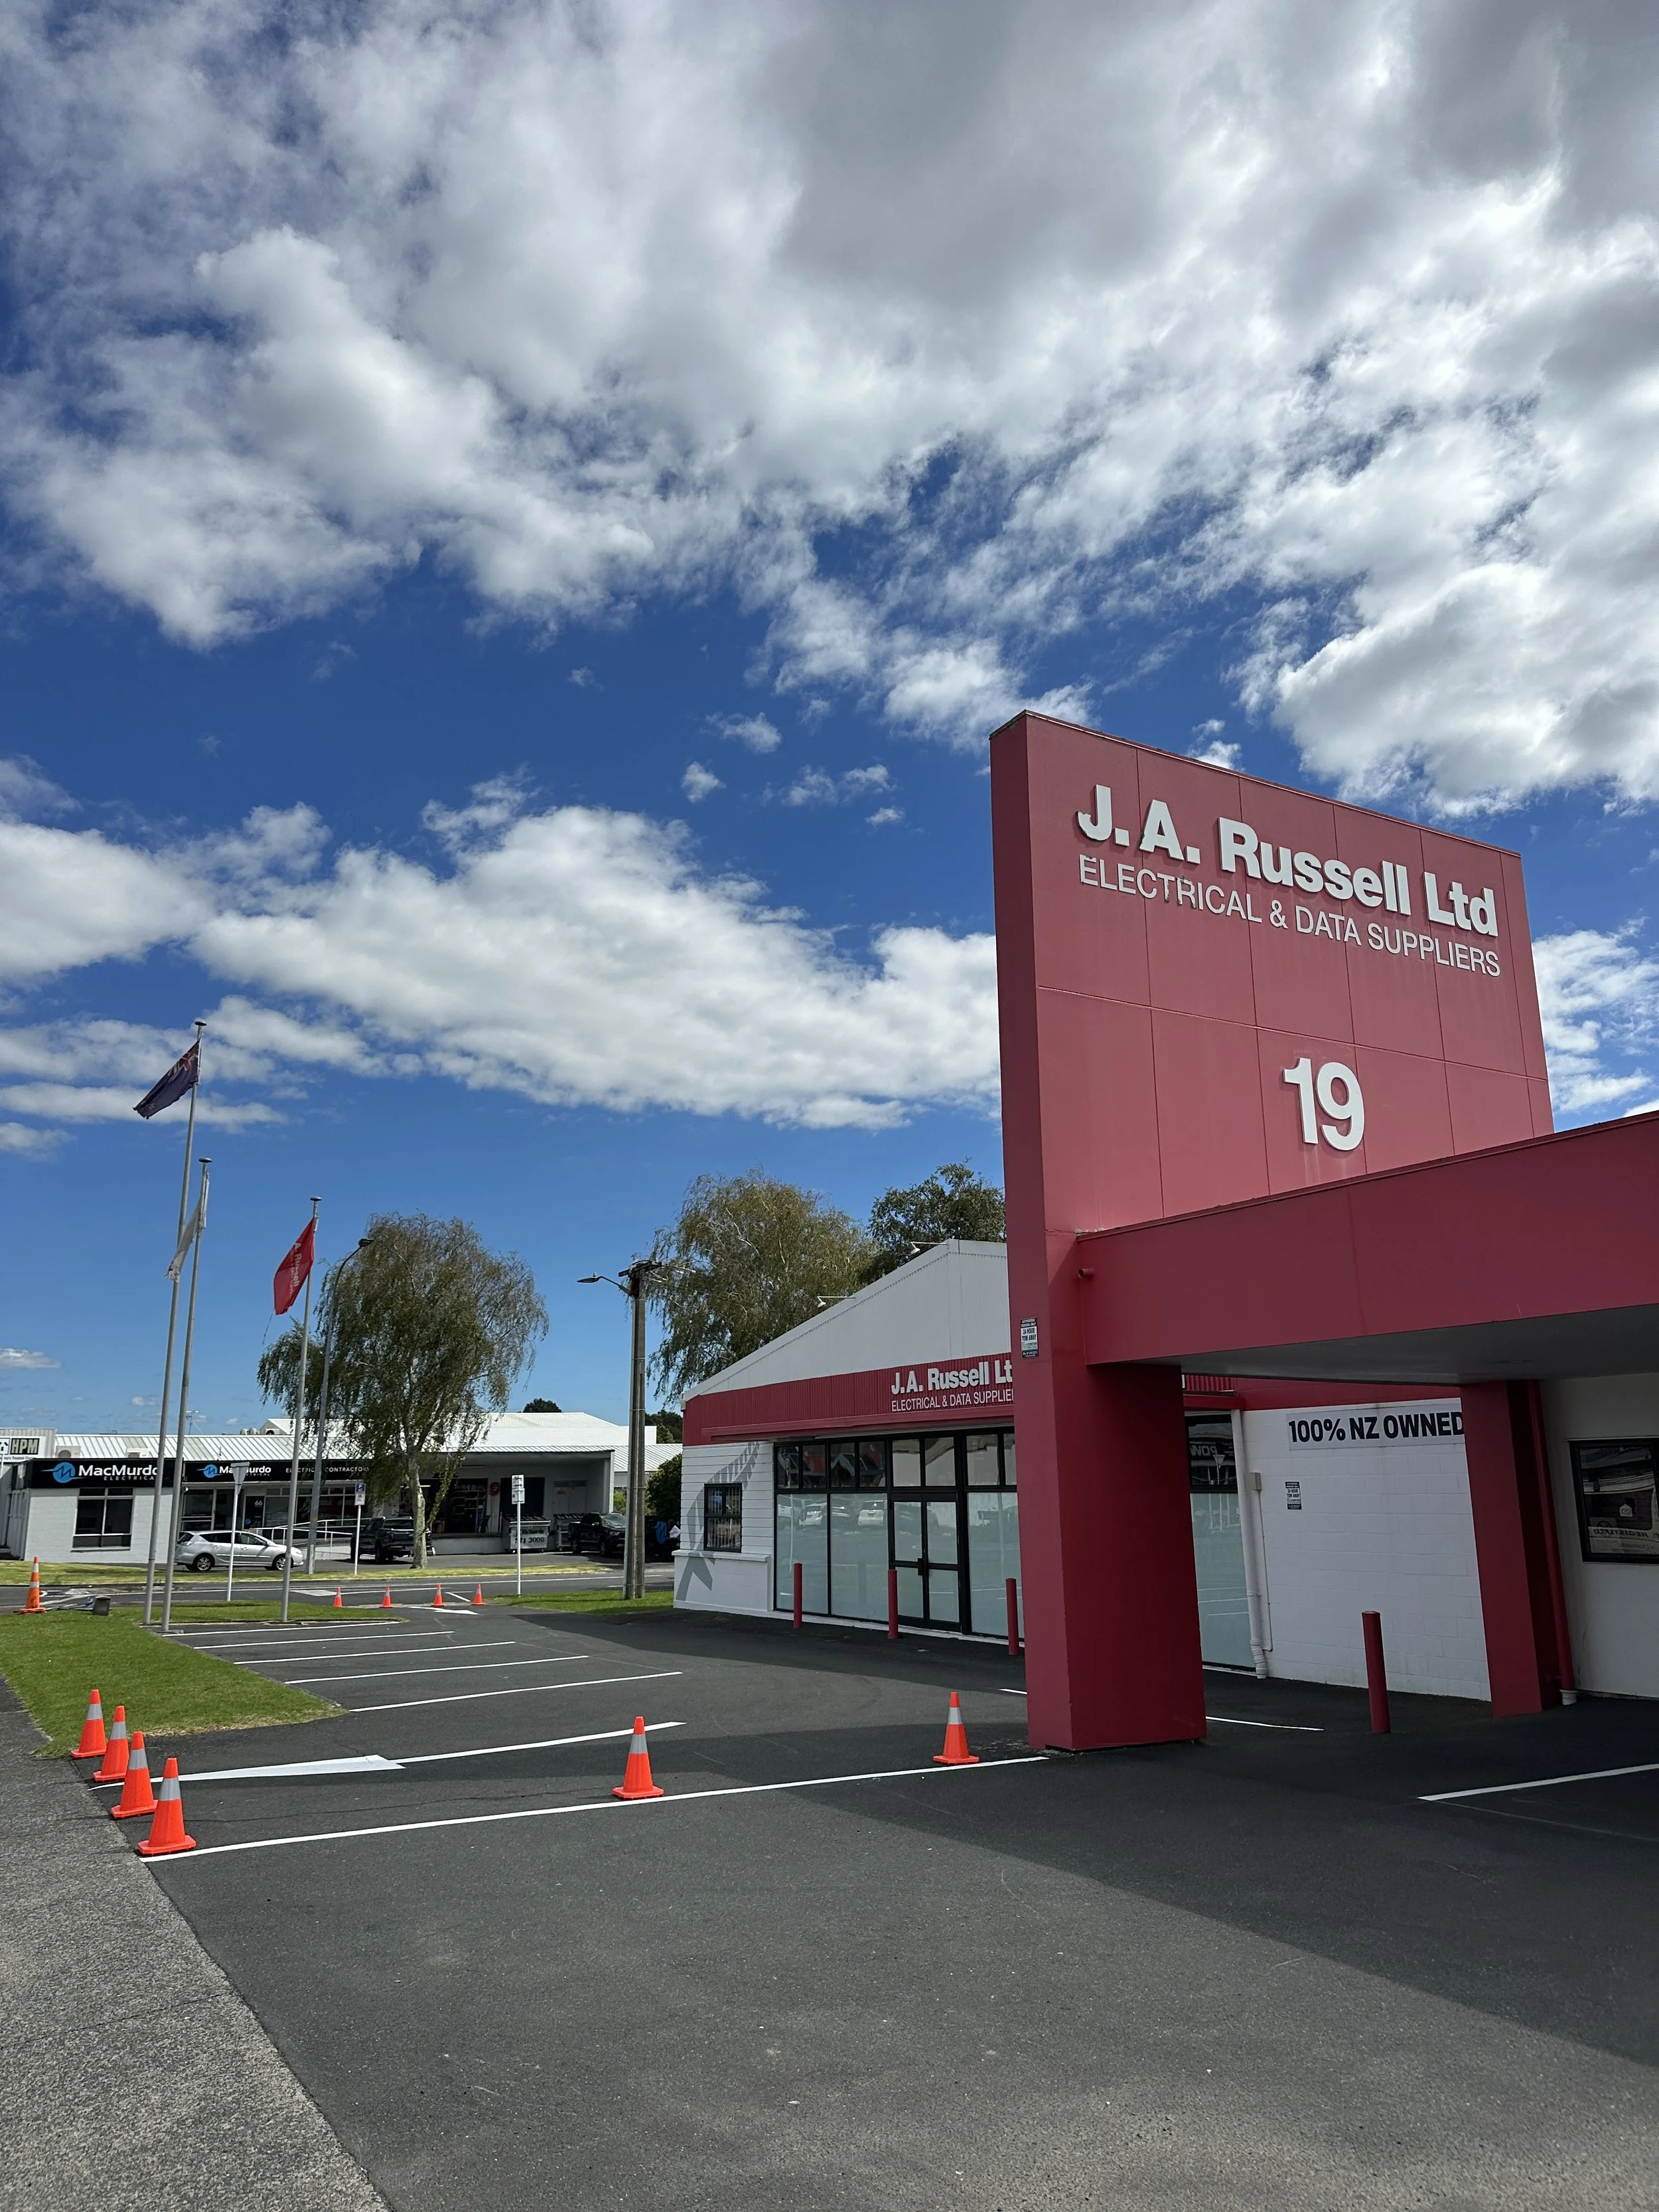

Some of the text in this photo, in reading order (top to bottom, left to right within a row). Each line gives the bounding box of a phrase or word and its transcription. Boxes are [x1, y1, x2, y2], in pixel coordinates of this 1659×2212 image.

[1077, 784, 1498, 937] J.A. Russell Ltd
[1079, 854, 1501, 978] ELECTRICAL & DATA SUPPLIERS
[1283, 1057, 1365, 1151] 19
[891, 1360, 1013, 1394] J.A. Russell Lt
[892, 1388, 1013, 1412] ELECTRICAL & DATA SUPPLIE
[1288, 1411, 1465, 1443] 100% NZ OWNED
[11, 1439, 38, 1453] HPM
